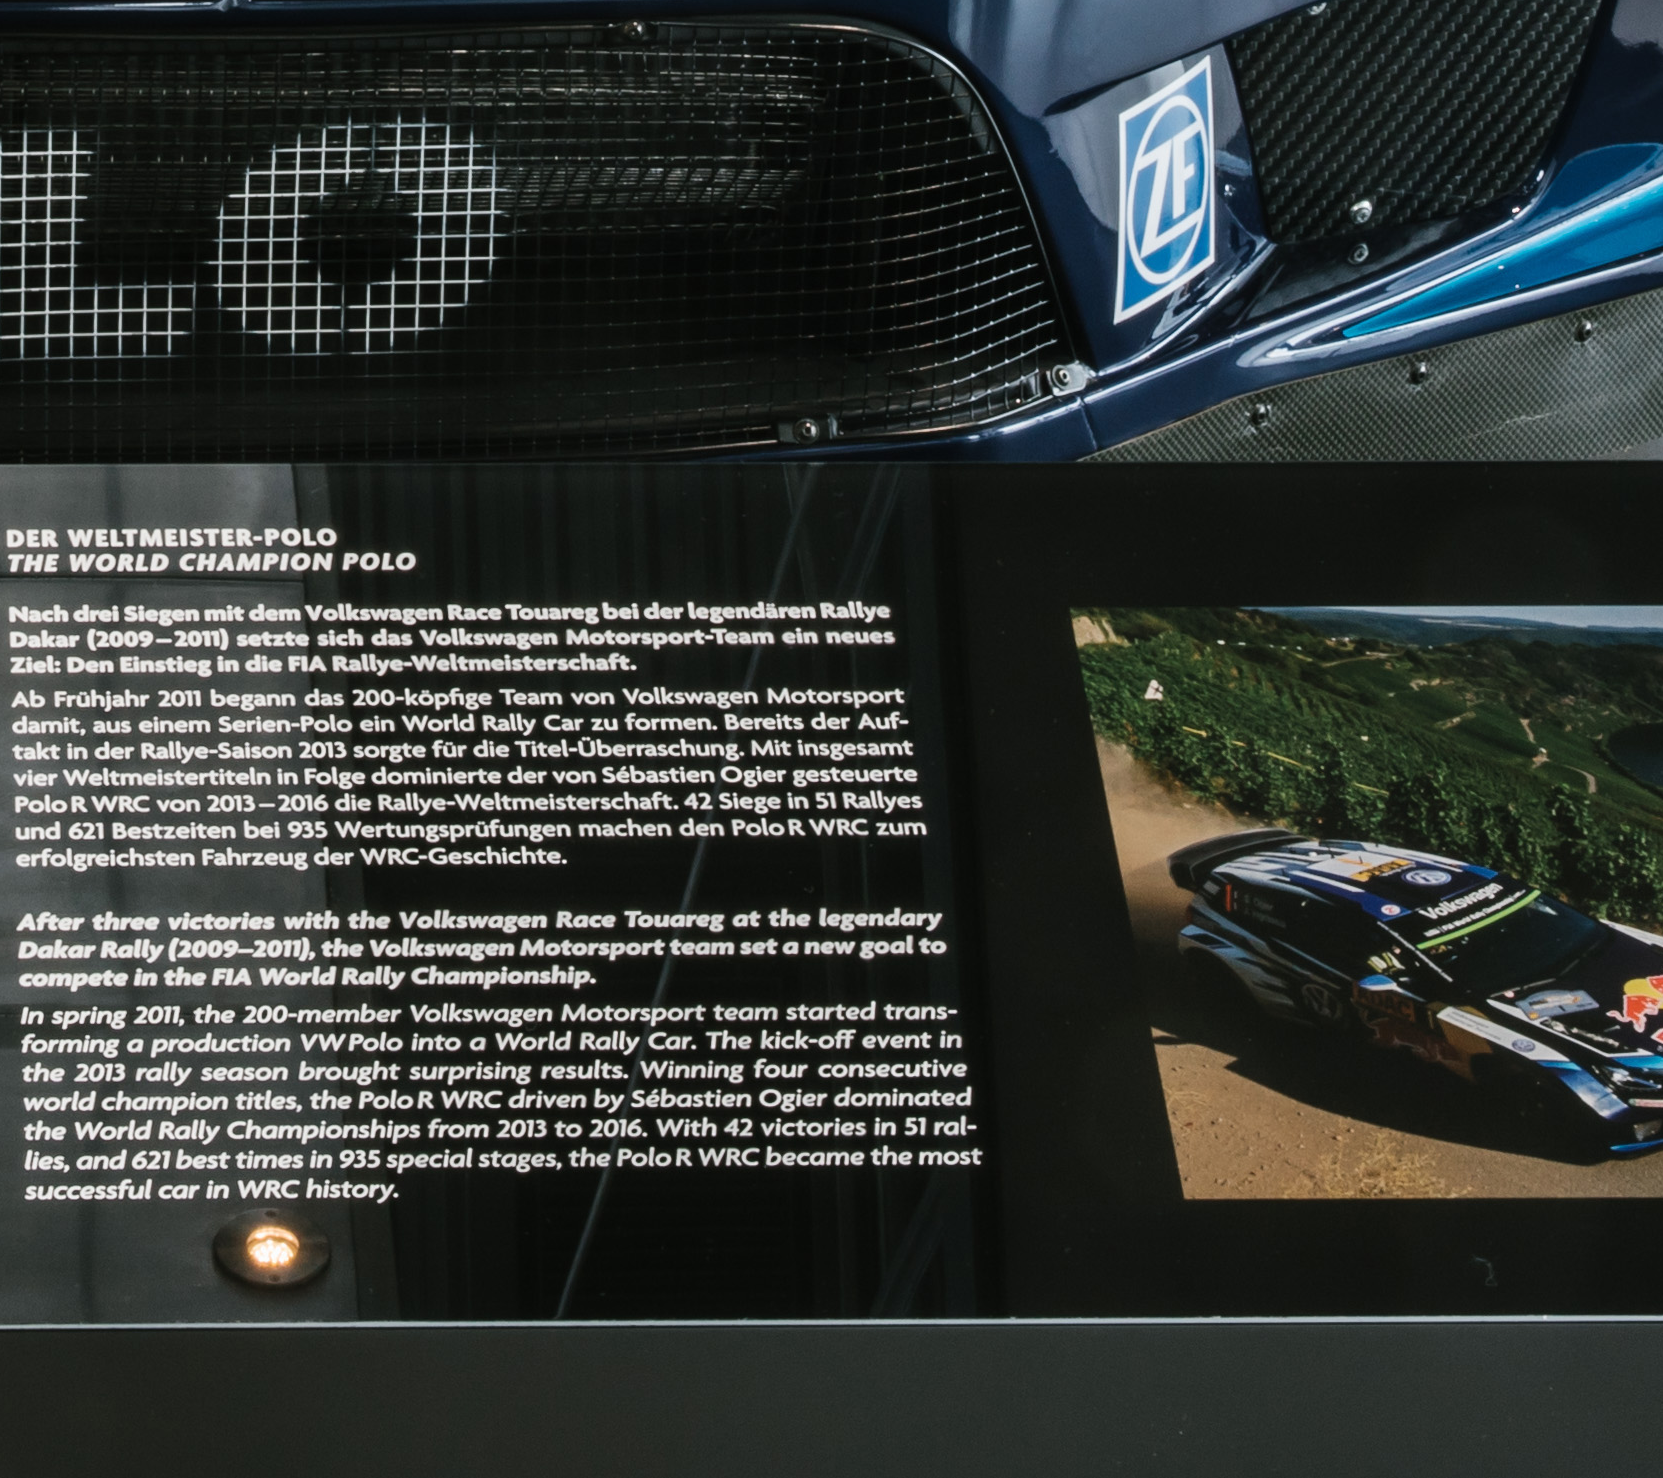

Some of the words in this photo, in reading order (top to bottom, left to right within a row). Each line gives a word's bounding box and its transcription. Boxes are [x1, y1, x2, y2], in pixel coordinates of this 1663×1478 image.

[6, 527, 59, 547] DER
[66, 526, 337, 548] WELTMEISTER-POLO
[7, 553, 60, 573] THE
[69, 552, 170, 573] WORLD
[178, 551, 333, 571] CHAMPION
[342, 552, 417, 571] POLO
[8, 602, 70, 623] Nach
[72, 603, 120, 623] drei
[123, 604, 201, 627] Siegen
[203, 603, 246, 622] mit
[248, 602, 302, 621] dem
[304, 601, 444, 626] Volkswagen
[446, 604, 503, 621] Race
[504, 603, 600, 624] Touareg
[601, 600, 640, 619] bei
[643, 600, 685, 619] der
[687, 600, 817, 624] legendären
[819, 599, 891, 622] Rallye
